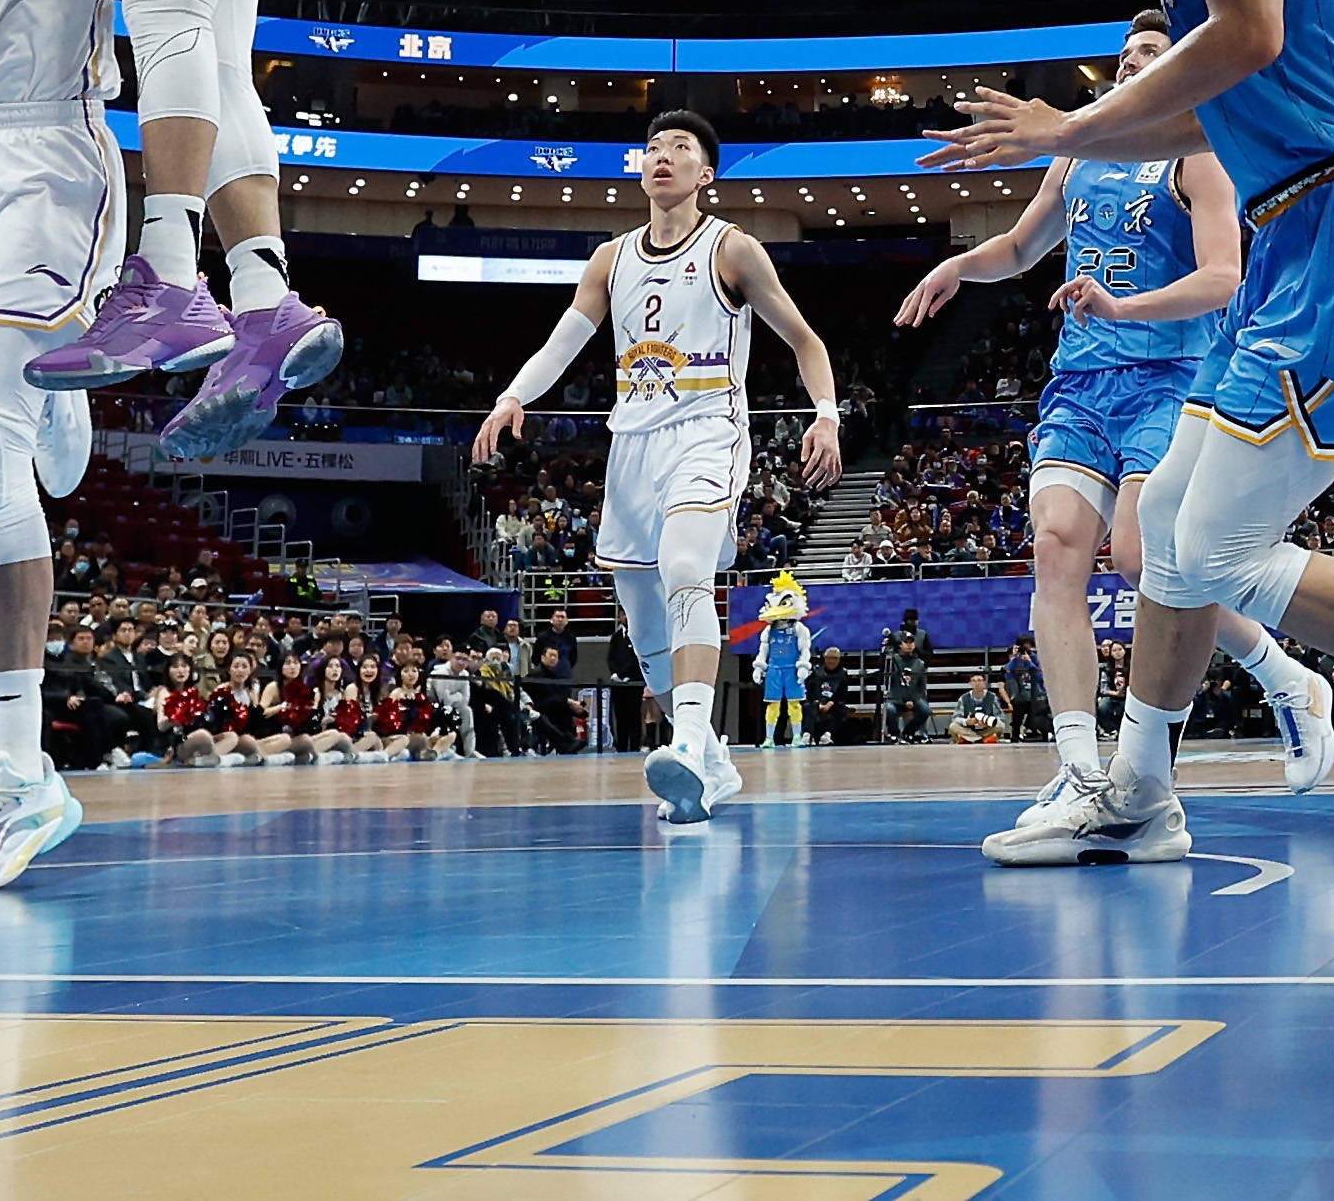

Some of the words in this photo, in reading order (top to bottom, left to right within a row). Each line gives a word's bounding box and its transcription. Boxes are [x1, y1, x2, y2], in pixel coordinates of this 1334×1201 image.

[400, 34, 452, 60] 北京
[1075, 247, 1139, 289] 22
[645, 294, 662, 332] 2
